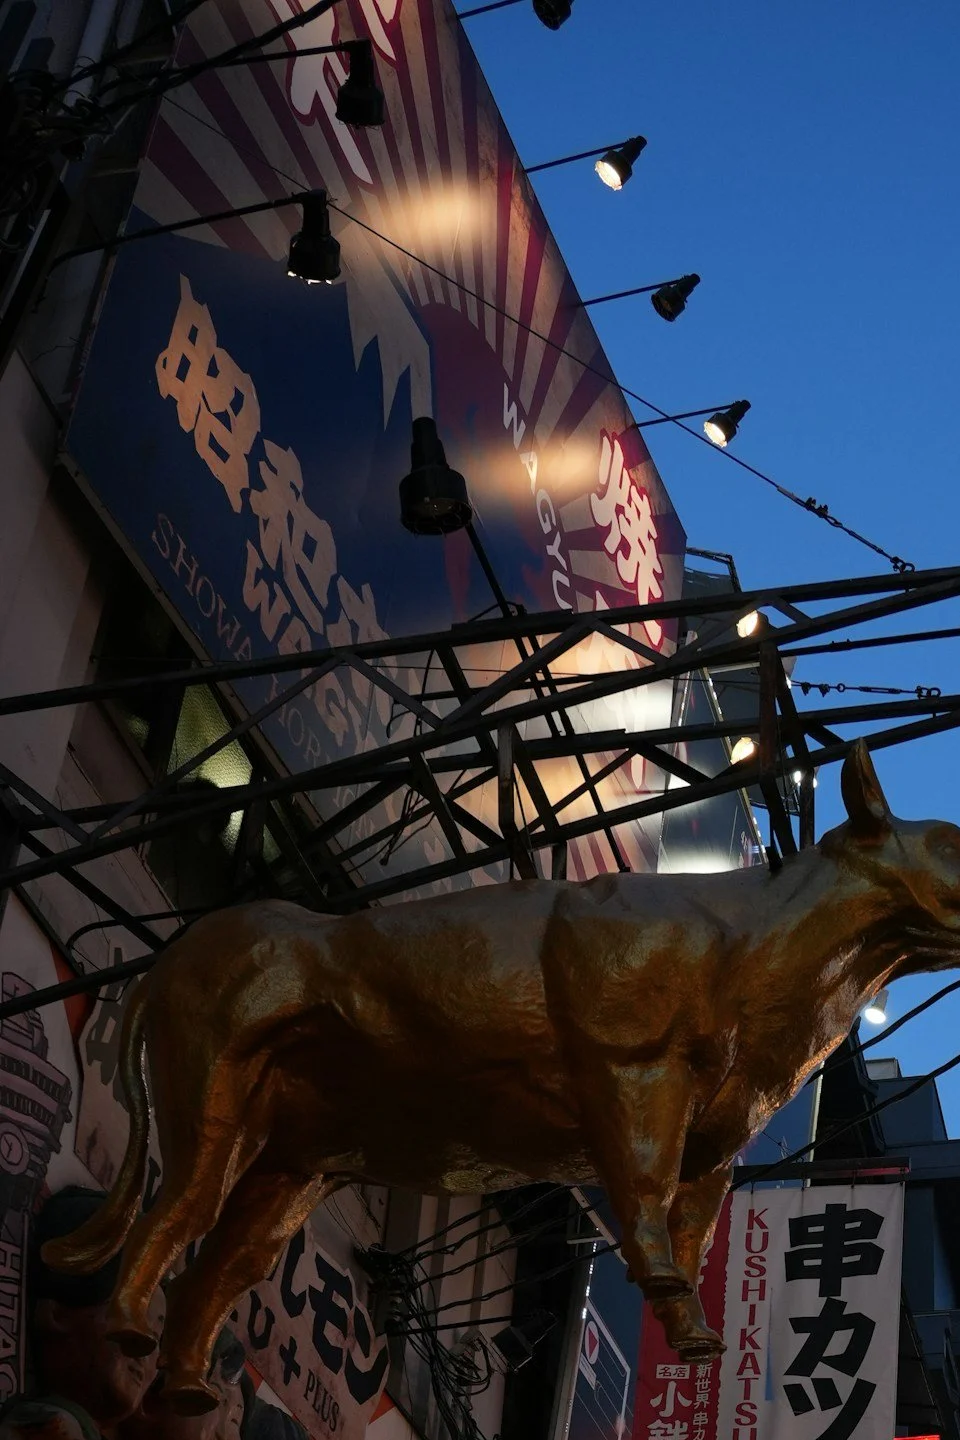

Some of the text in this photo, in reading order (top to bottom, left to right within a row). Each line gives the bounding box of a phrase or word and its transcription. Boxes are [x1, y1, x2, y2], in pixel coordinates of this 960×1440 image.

[502, 382, 573, 612] WAGYU
[151, 512, 255, 665] SHOWA
[302, 1367, 343, 1435] PLUS
[657, 1364, 690, 1379] 名店
